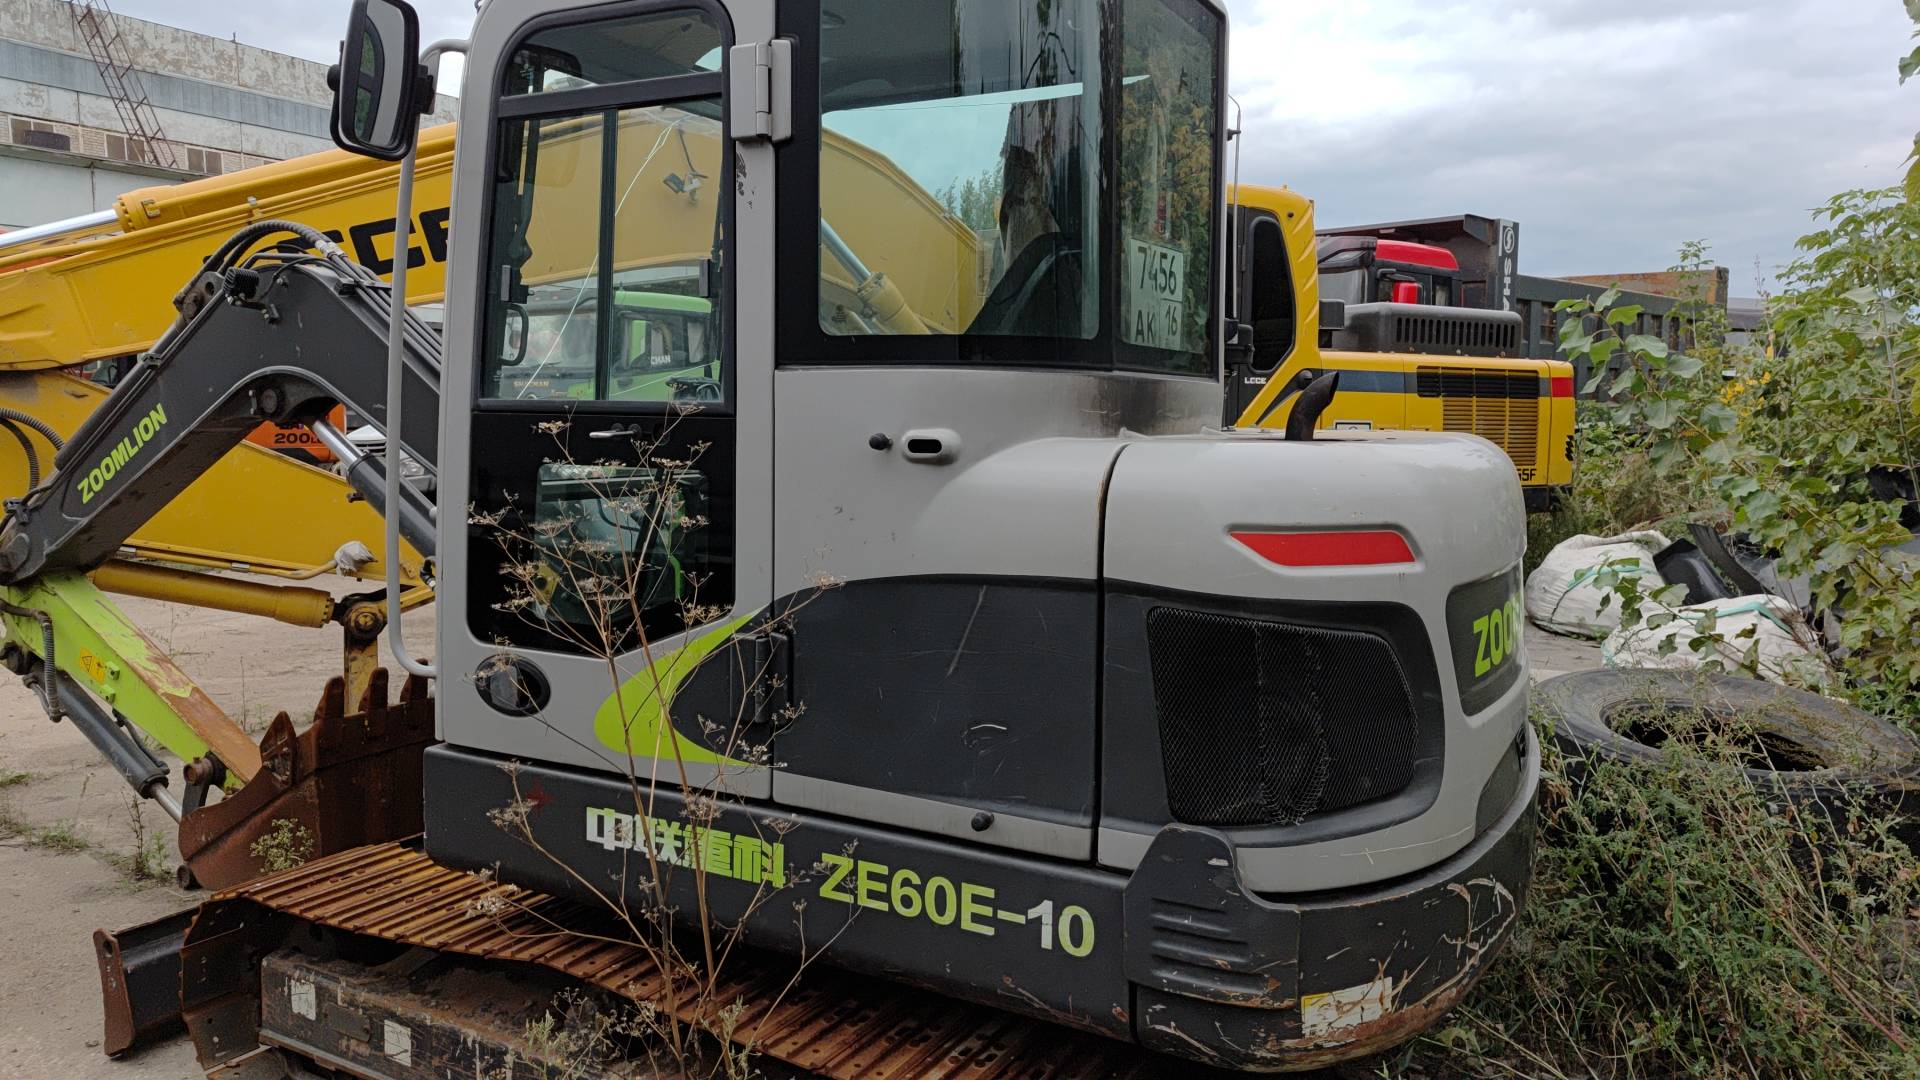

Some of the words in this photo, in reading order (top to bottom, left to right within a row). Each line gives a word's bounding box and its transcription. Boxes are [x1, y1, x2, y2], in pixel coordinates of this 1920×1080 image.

[1137, 245, 1177, 296] 7456
[1165, 303, 1178, 336] 16
[77, 402, 168, 505] ZOOMLION
[819, 852, 1095, 958] ZE60E-10
